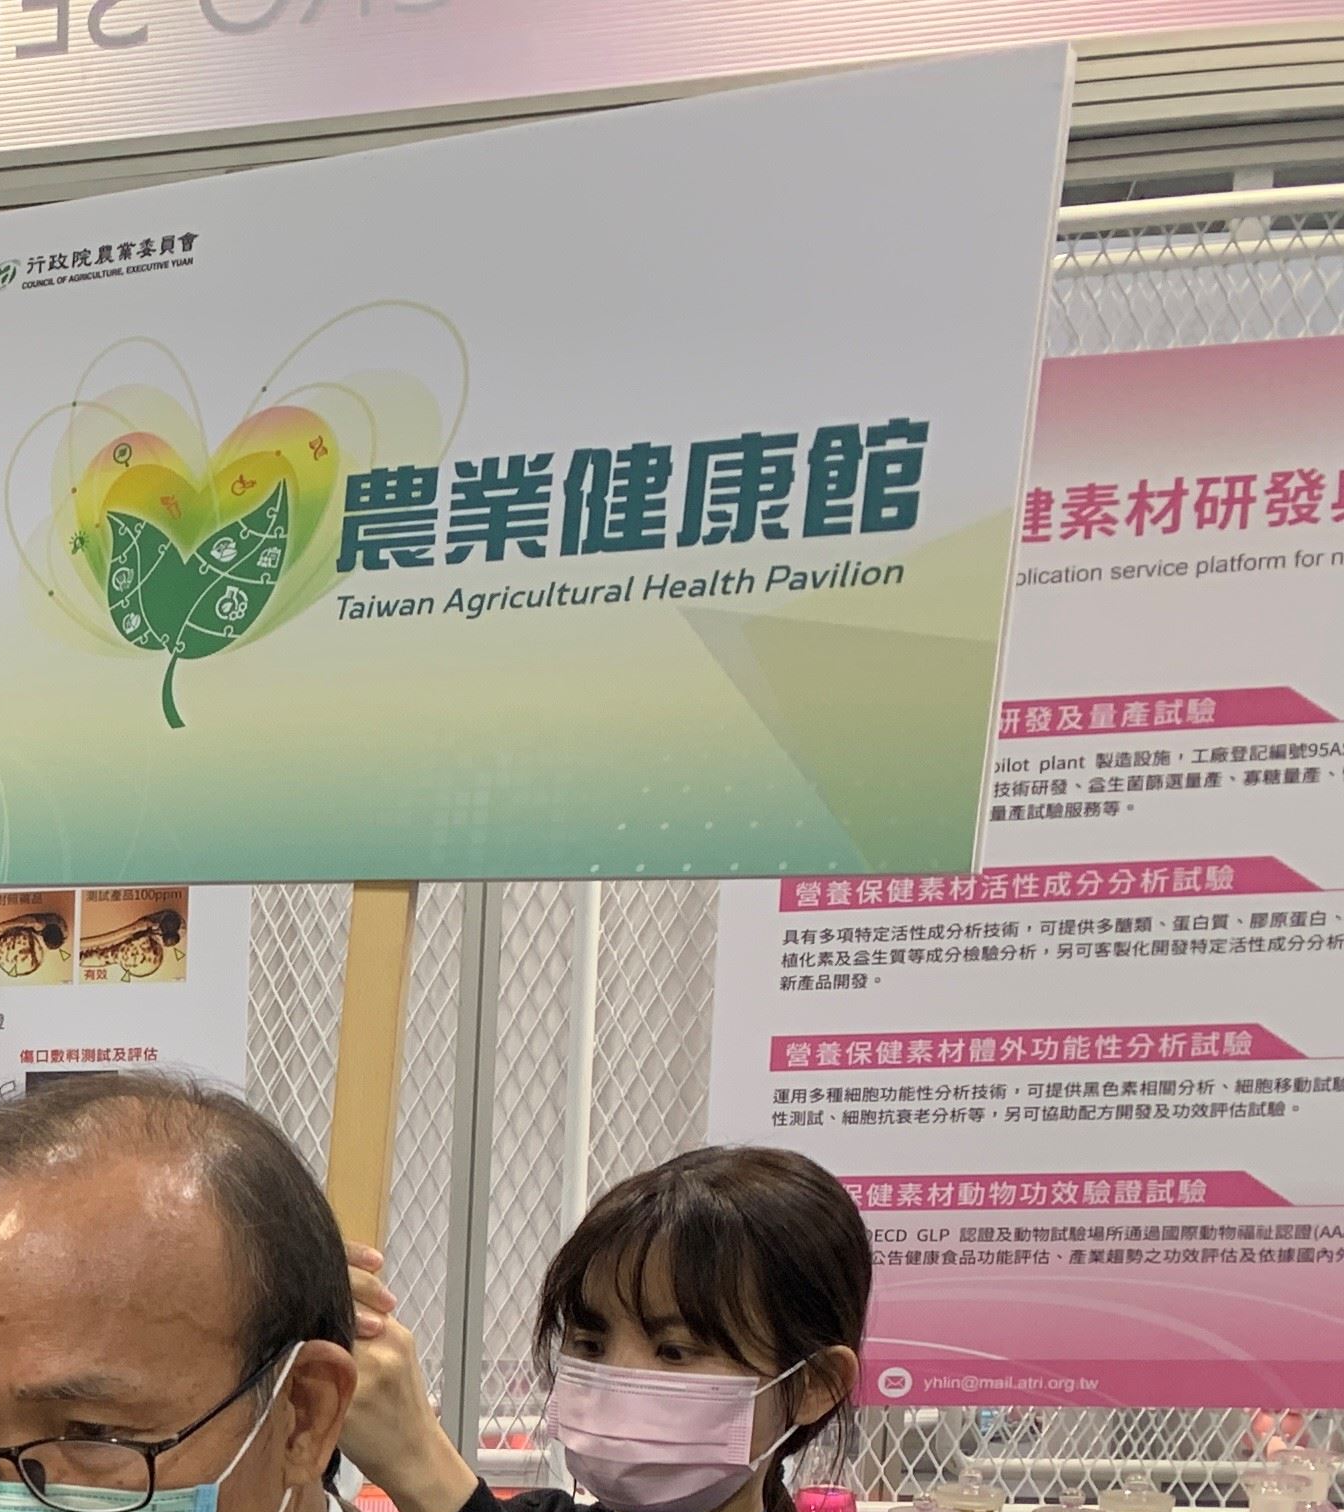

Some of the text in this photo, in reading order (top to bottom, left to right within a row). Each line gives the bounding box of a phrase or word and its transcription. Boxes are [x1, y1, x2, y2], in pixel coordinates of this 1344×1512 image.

[25, 231, 200, 275] 行政院農業委員會
[21, 278, 55, 291] COUNCIL
[56, 275, 68, 286] OF
[125, 259, 170, 275] EXECUTIVE
[171, 256, 195, 269] YUAN
[335, 417, 931, 574] 農業健康館
[1110, 559, 1188, 581] service
[1195, 552, 1286, 577] platform
[1295, 550, 1325, 567] for
[336, 560, 904, 622] Taiwan Agricultural Health Pavilion
[1039, 756, 1086, 775] plant
[795, 864, 1235, 908] 營養保健素材活性成分分析試驗
[84, 968, 108, 981] 有效
[779, 972, 882, 992] 新產品開發。
[785, 1030, 1253, 1068] 營養保健素材體外功能性分析試驗
[917, 1228, 950, 1243] GLP
[923, 1373, 1100, 1395] yhlin@mail.atri.org.tw
